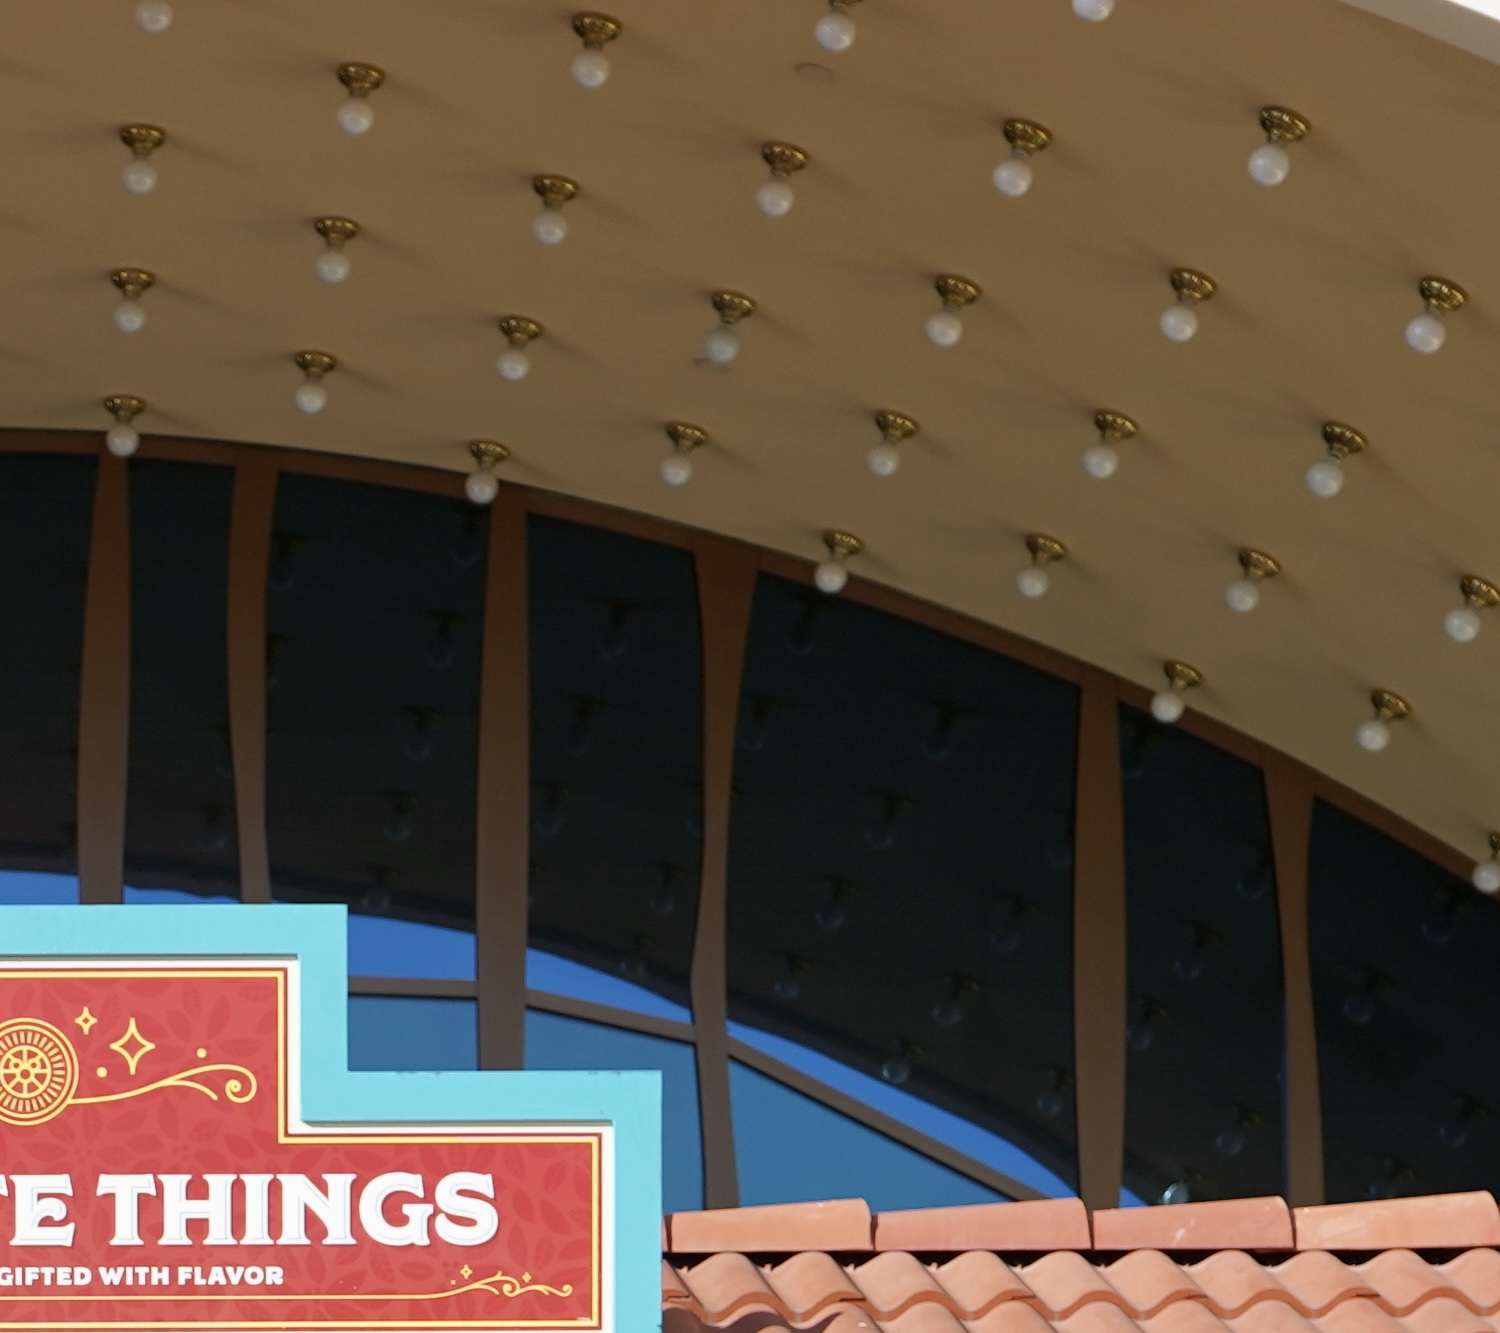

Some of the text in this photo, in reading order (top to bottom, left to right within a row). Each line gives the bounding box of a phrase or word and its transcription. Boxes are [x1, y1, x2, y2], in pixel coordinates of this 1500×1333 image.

[96, 1172, 499, 1247] THINGS
[99, 1265, 170, 1286] WITH
[177, 1265, 284, 1286] FLAVOR
